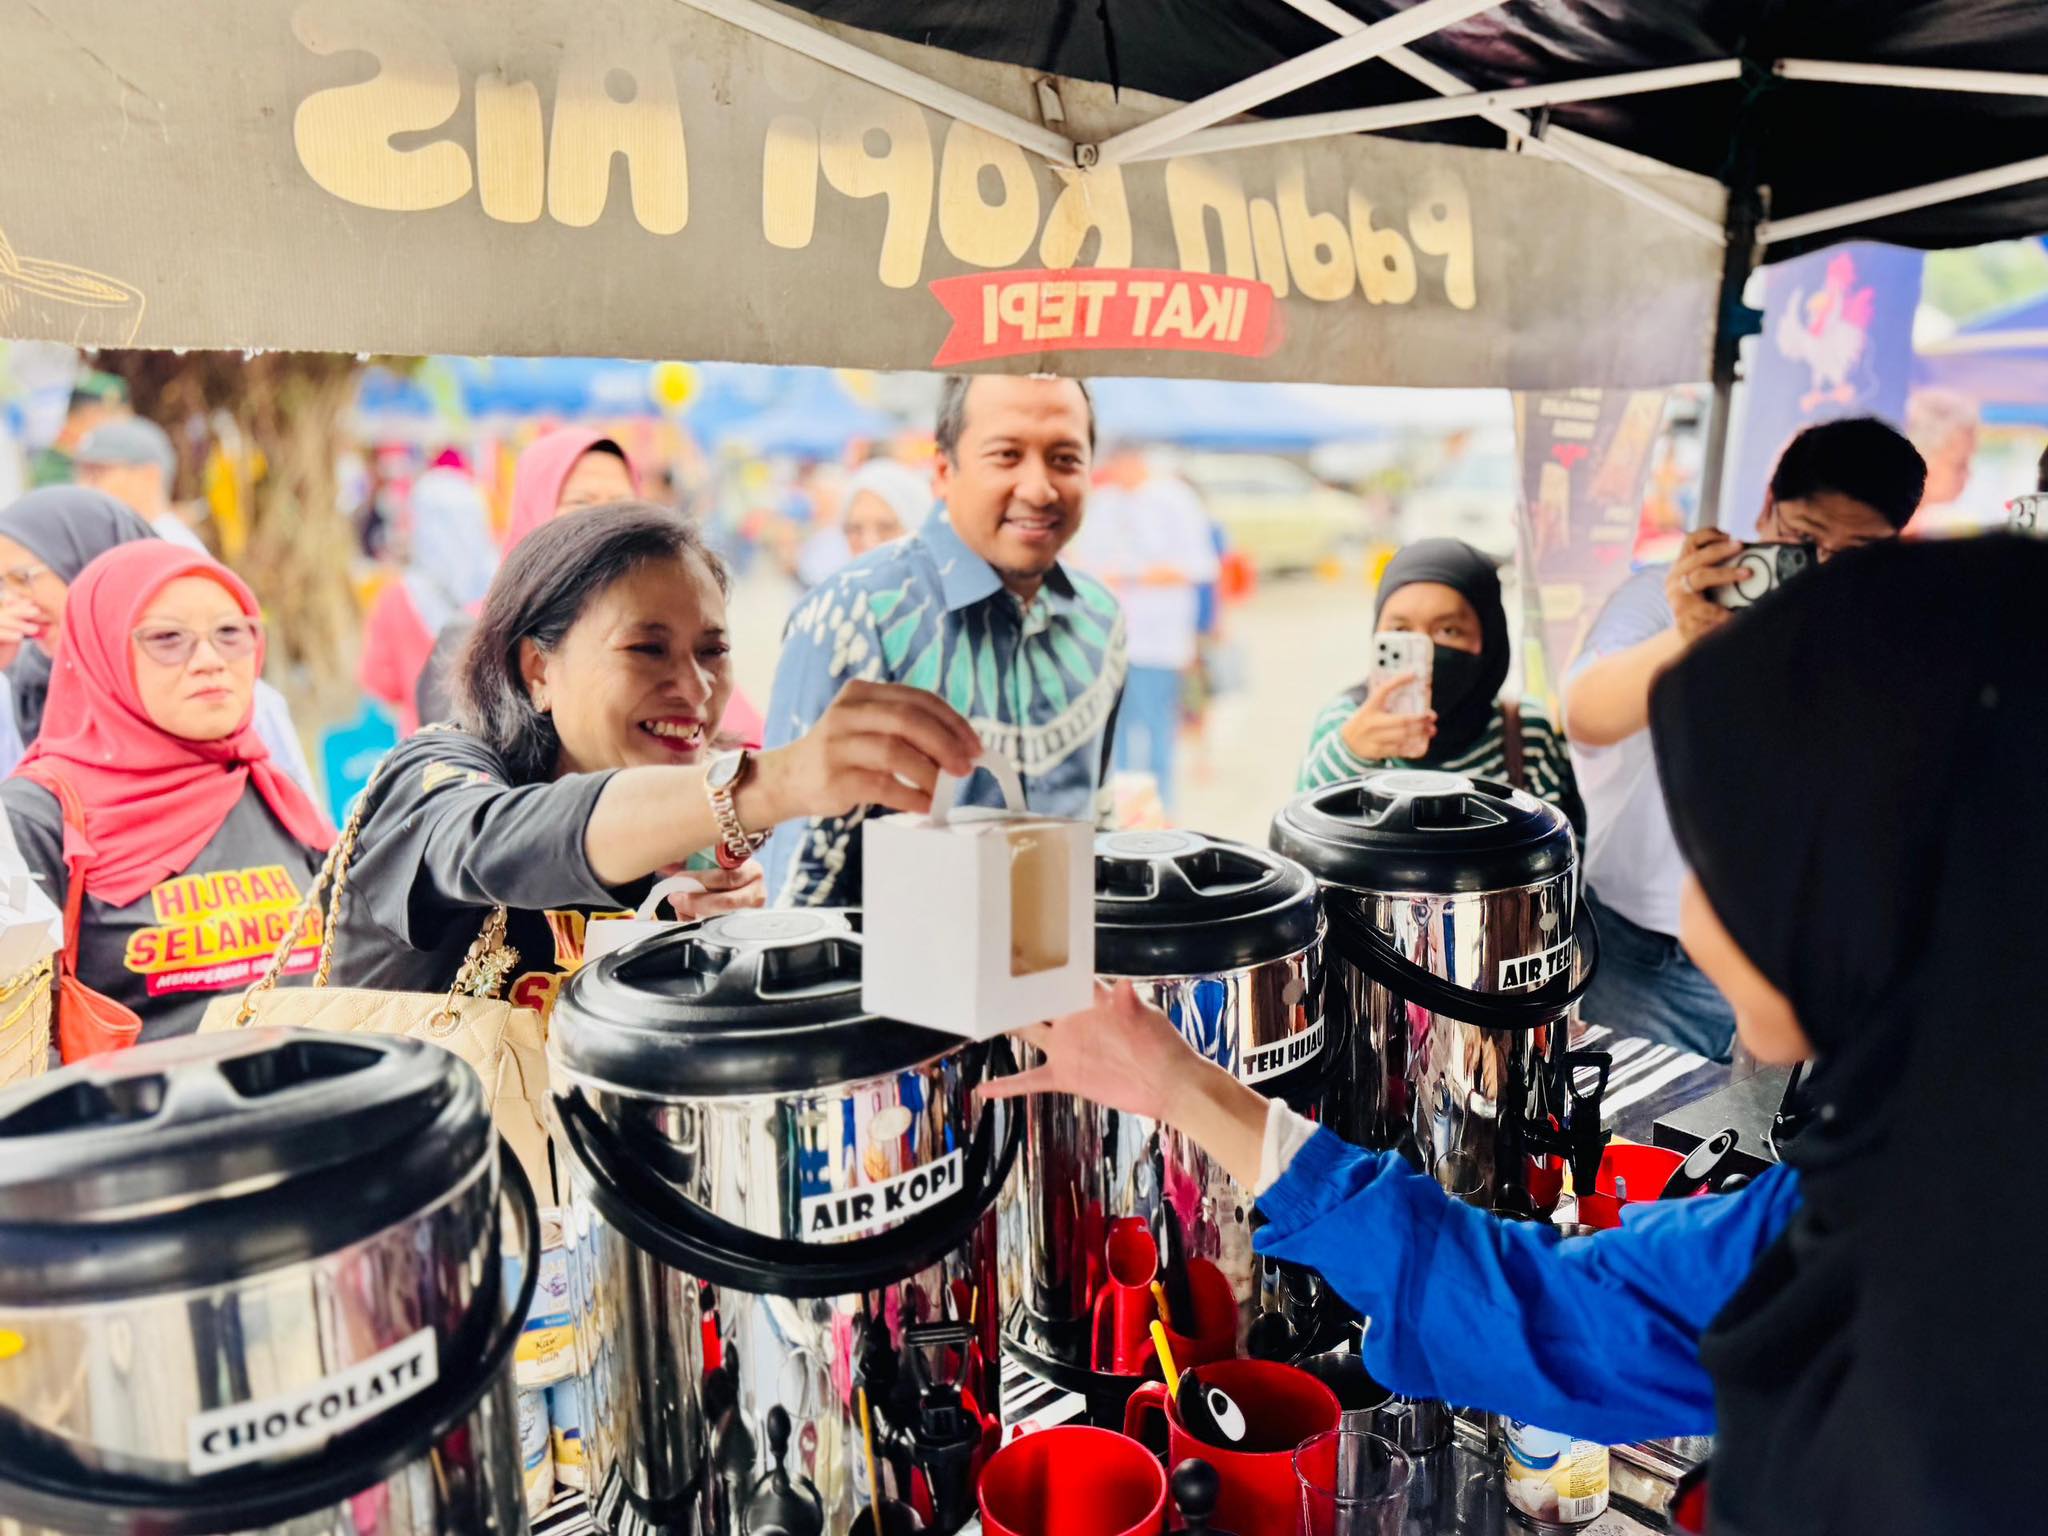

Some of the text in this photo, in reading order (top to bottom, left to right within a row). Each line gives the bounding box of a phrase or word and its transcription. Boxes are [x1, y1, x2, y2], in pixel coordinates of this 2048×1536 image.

[157, 869, 299, 918] HIJRAH
[1502, 940, 1571, 988] AIR TEH
[1243, 1024, 1323, 1075] TEH HIJAU
[811, 1157, 955, 1232] AIR KOPI
[202, 1354, 422, 1454] CHOCOLATE
